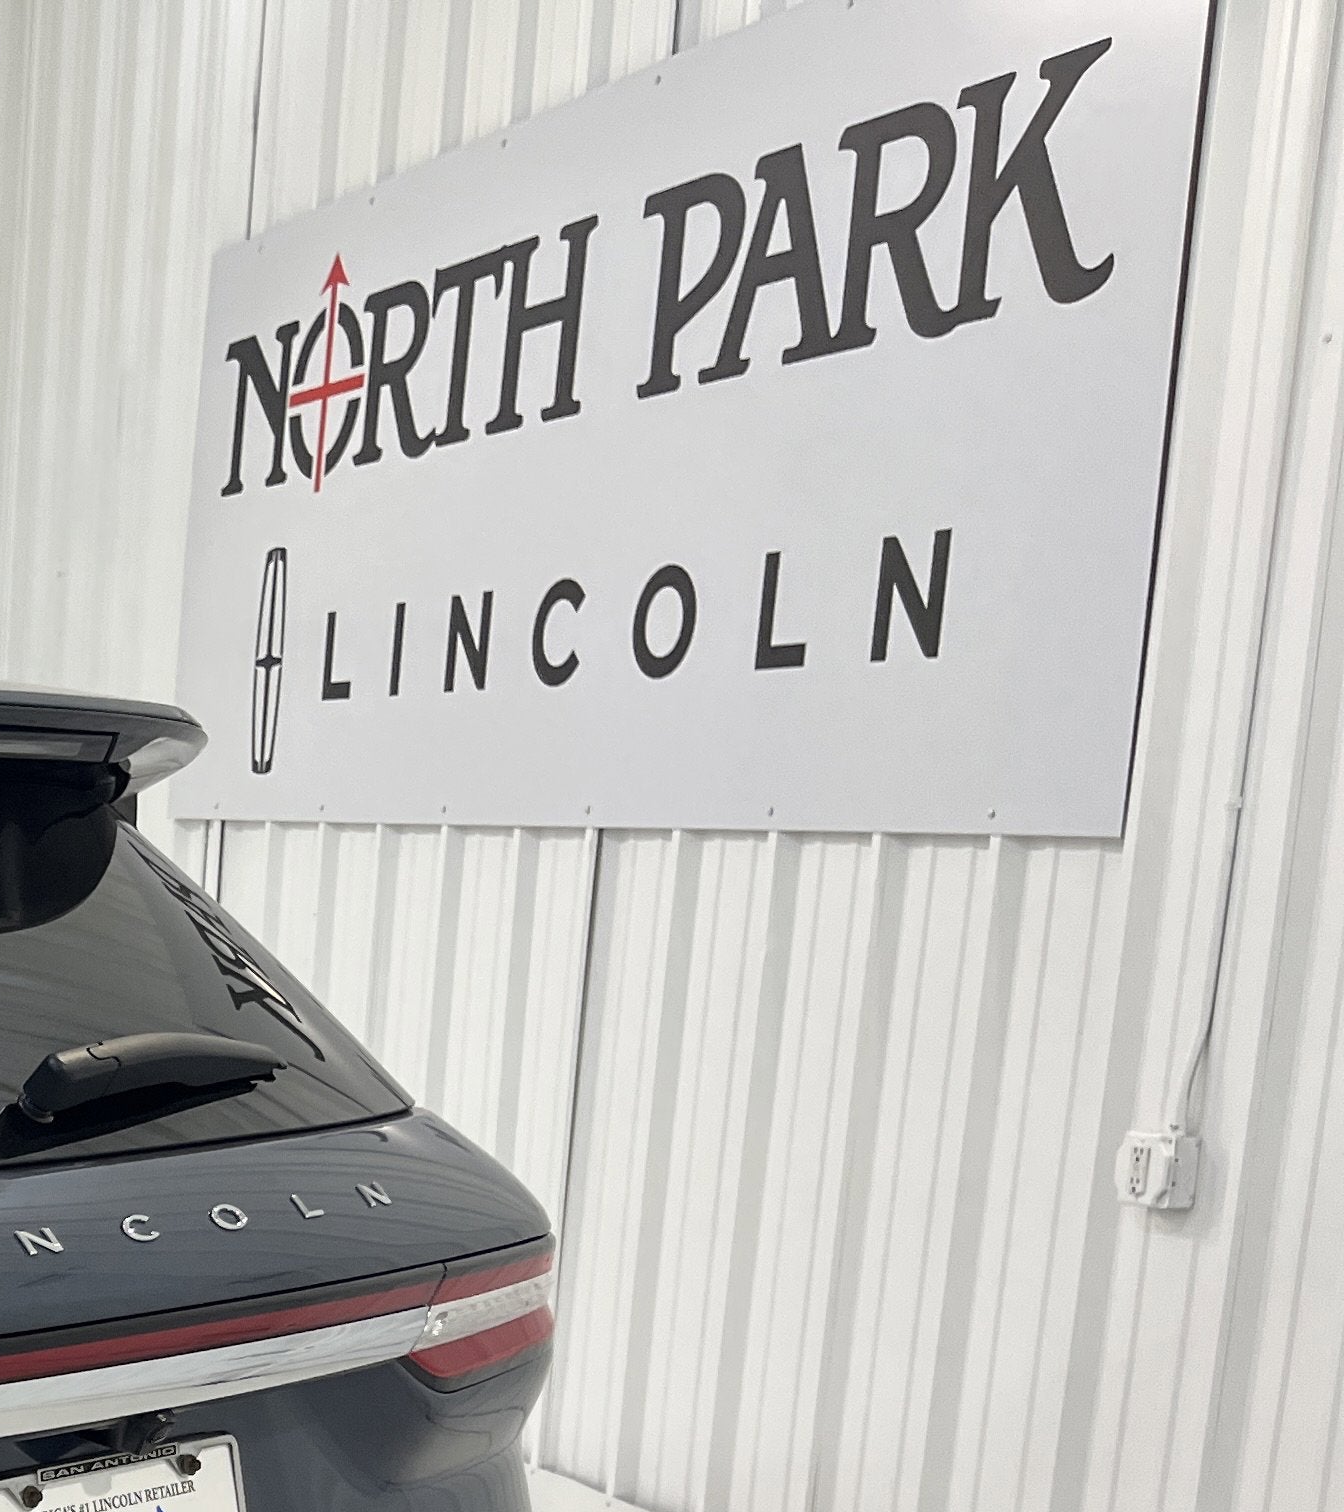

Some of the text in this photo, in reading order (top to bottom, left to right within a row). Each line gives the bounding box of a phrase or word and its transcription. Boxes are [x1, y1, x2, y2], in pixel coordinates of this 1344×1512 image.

[220, 36, 1115, 497] NORTH PARK
[321, 528, 952, 701] LINCOLN
[42, 1465, 85, 1481] SAN
[146, 1479, 196, 1502] RETAILER
